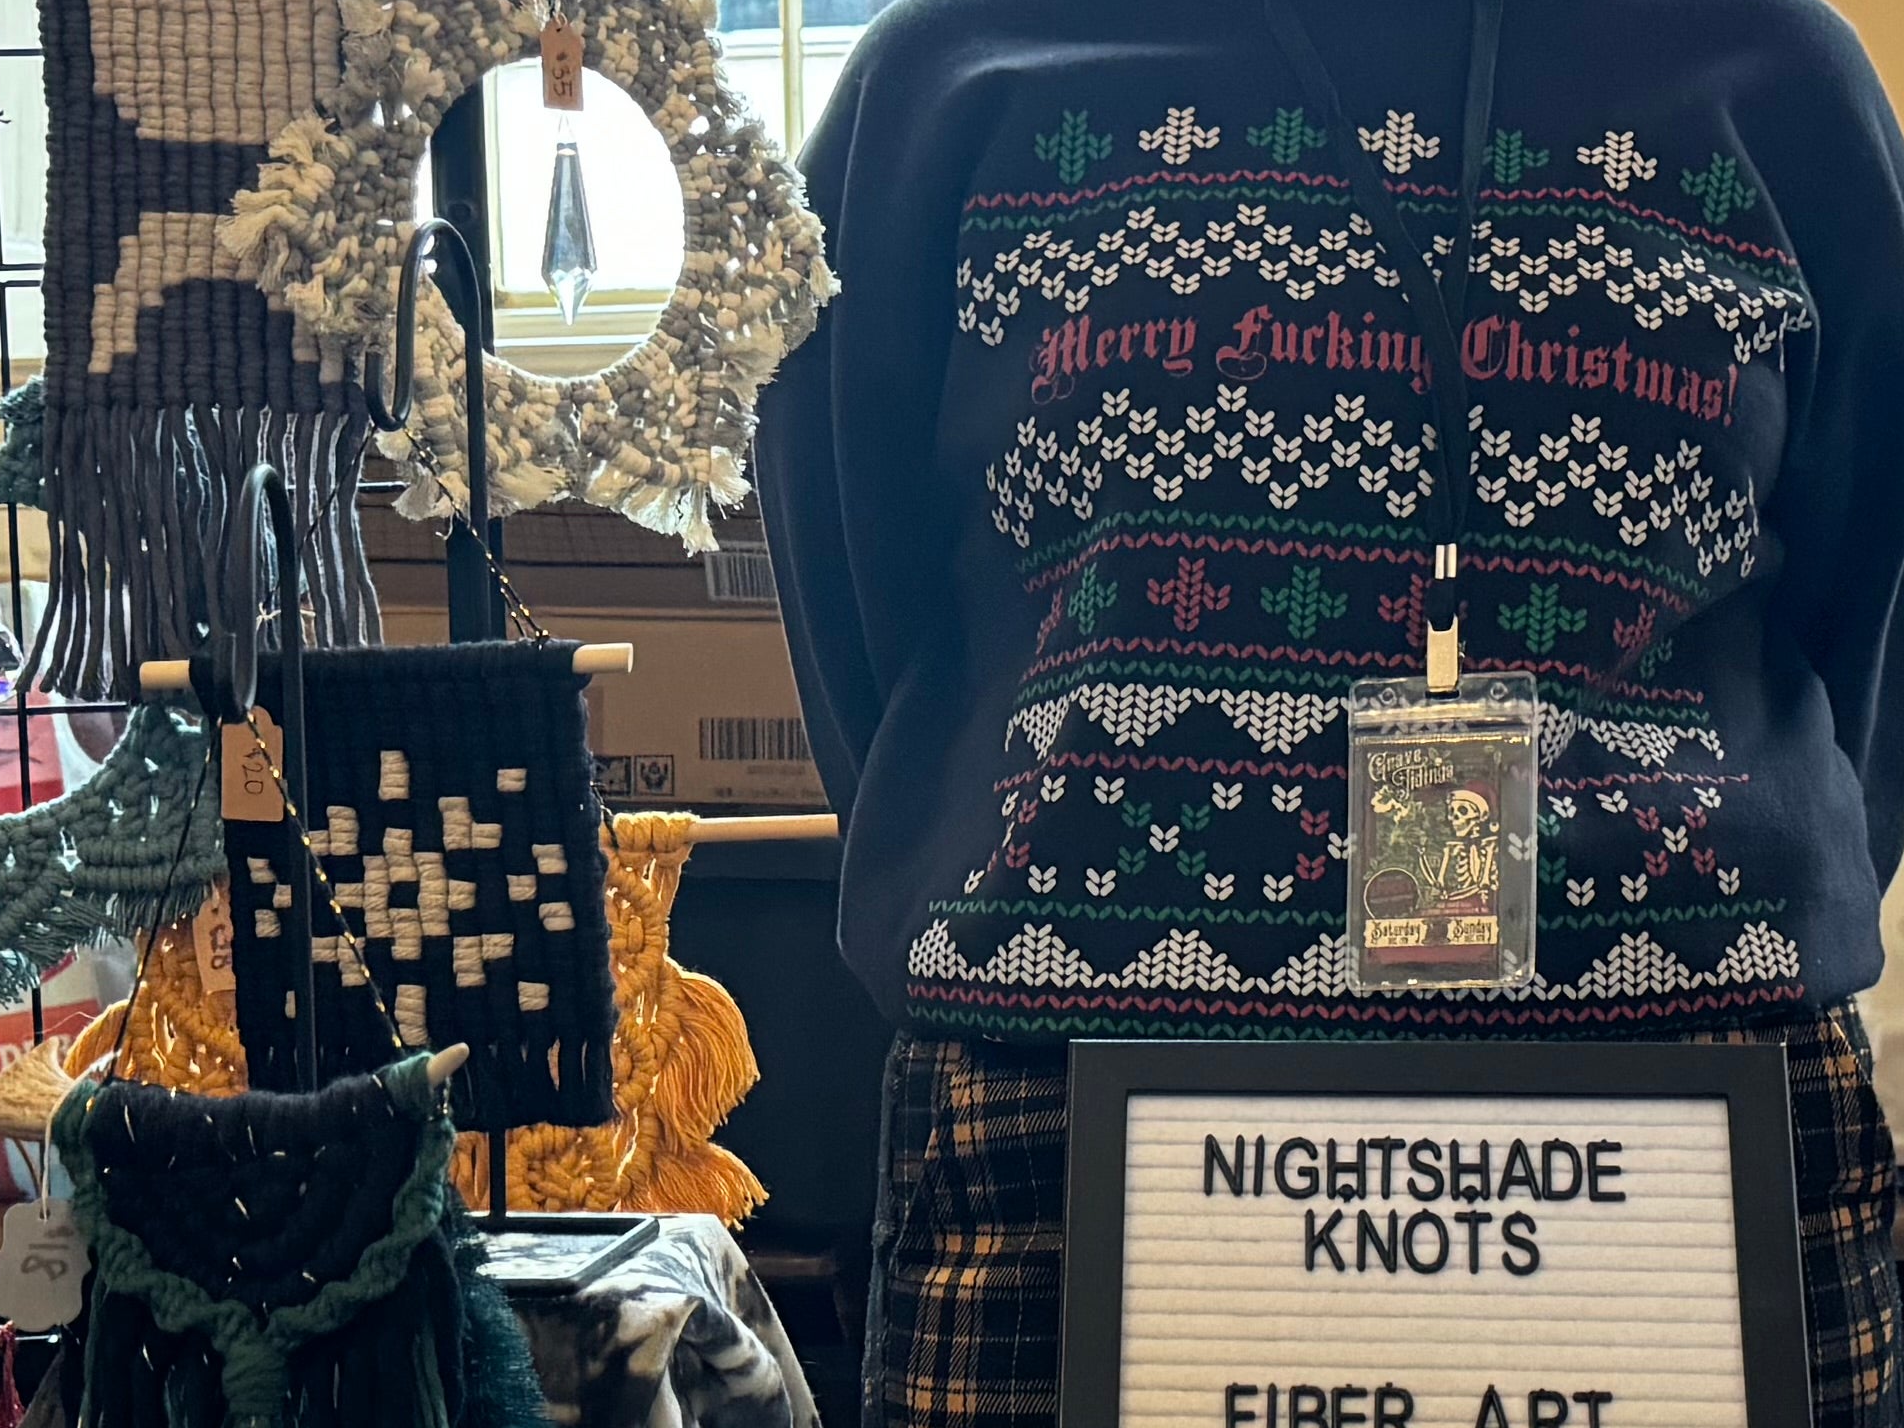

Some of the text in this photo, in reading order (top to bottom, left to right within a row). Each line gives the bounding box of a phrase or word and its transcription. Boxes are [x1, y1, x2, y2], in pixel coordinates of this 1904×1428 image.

[1031, 304, 1739, 428] Merry Fucking Christmas!
[1453, 918, 1492, 943] Sunday
[1202, 1133, 1626, 1203] NIGHTSHADE
[1303, 1208, 1542, 1276] KNOTS
